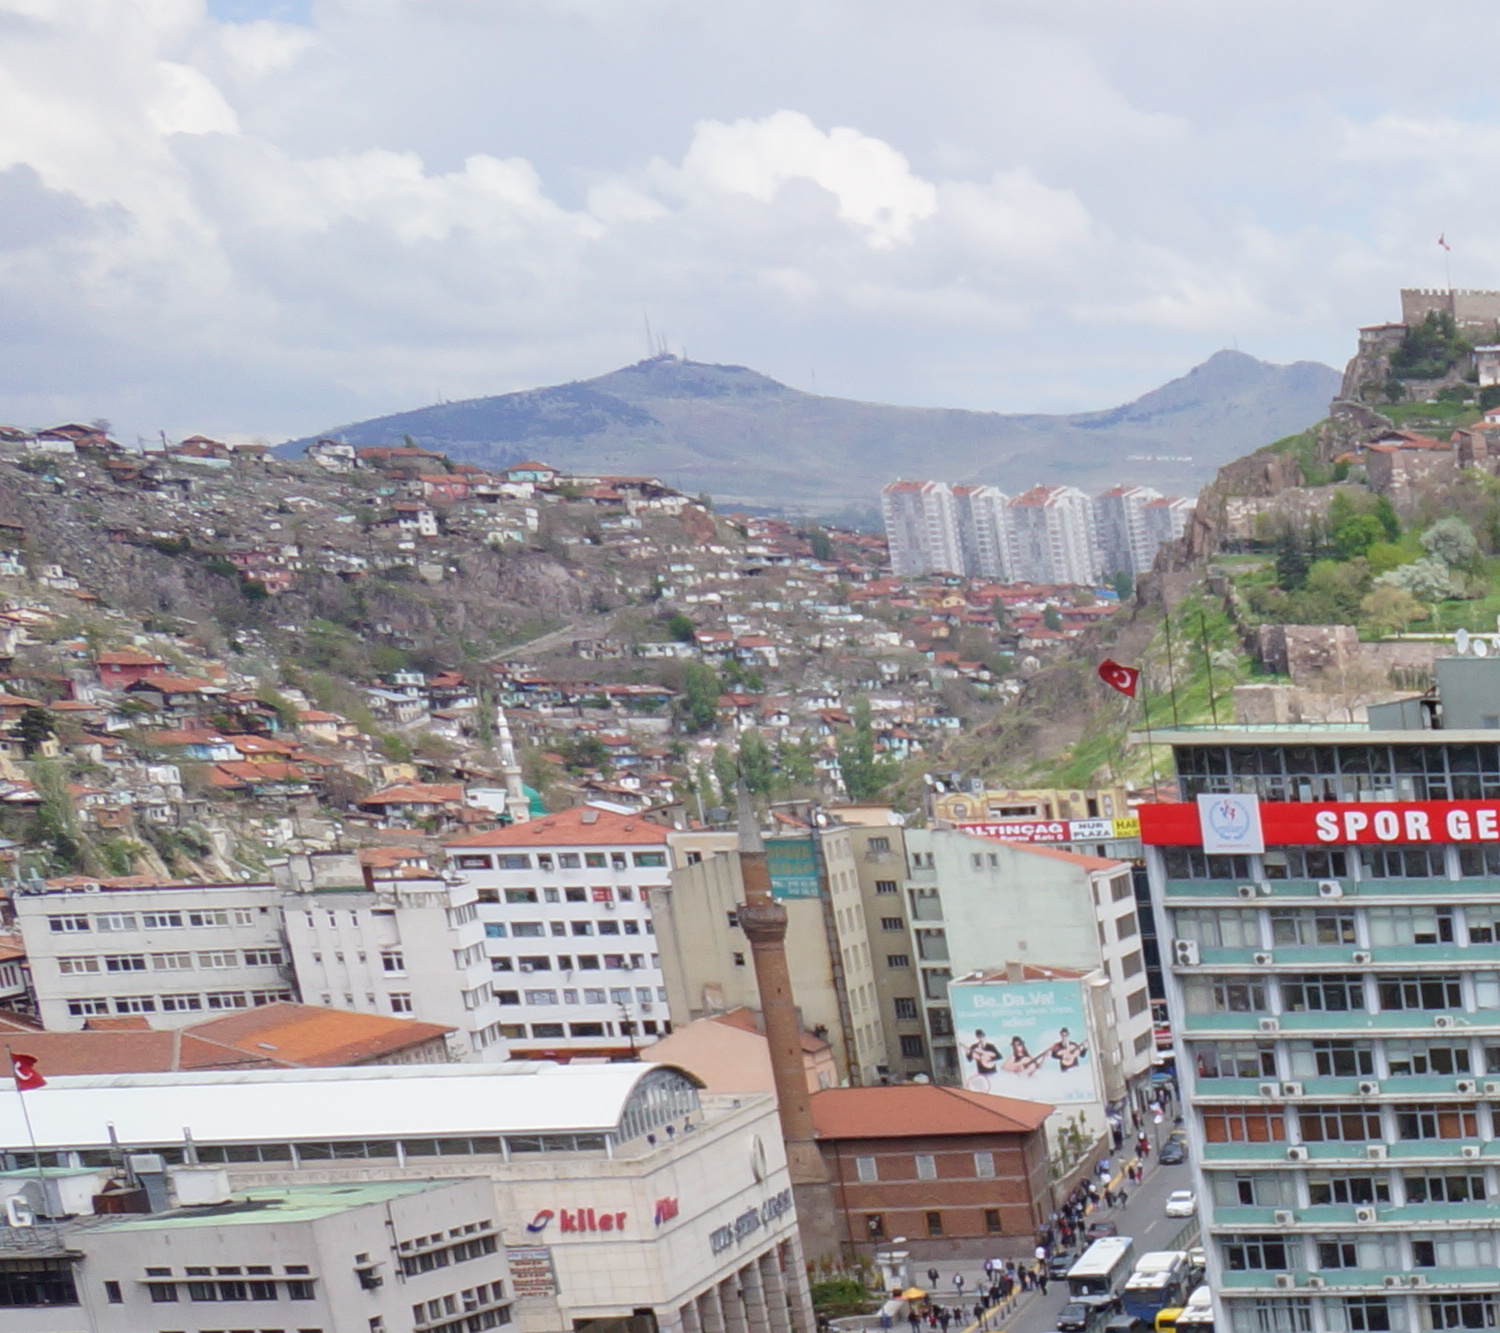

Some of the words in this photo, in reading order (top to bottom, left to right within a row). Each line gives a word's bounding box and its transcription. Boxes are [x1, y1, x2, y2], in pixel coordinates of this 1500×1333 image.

[1073, 829, 1111, 839] PLAZA
[1079, 822, 1104, 830] NUR
[1315, 811, 1432, 841] SPOR
[560, 1208, 627, 1232] kiler
